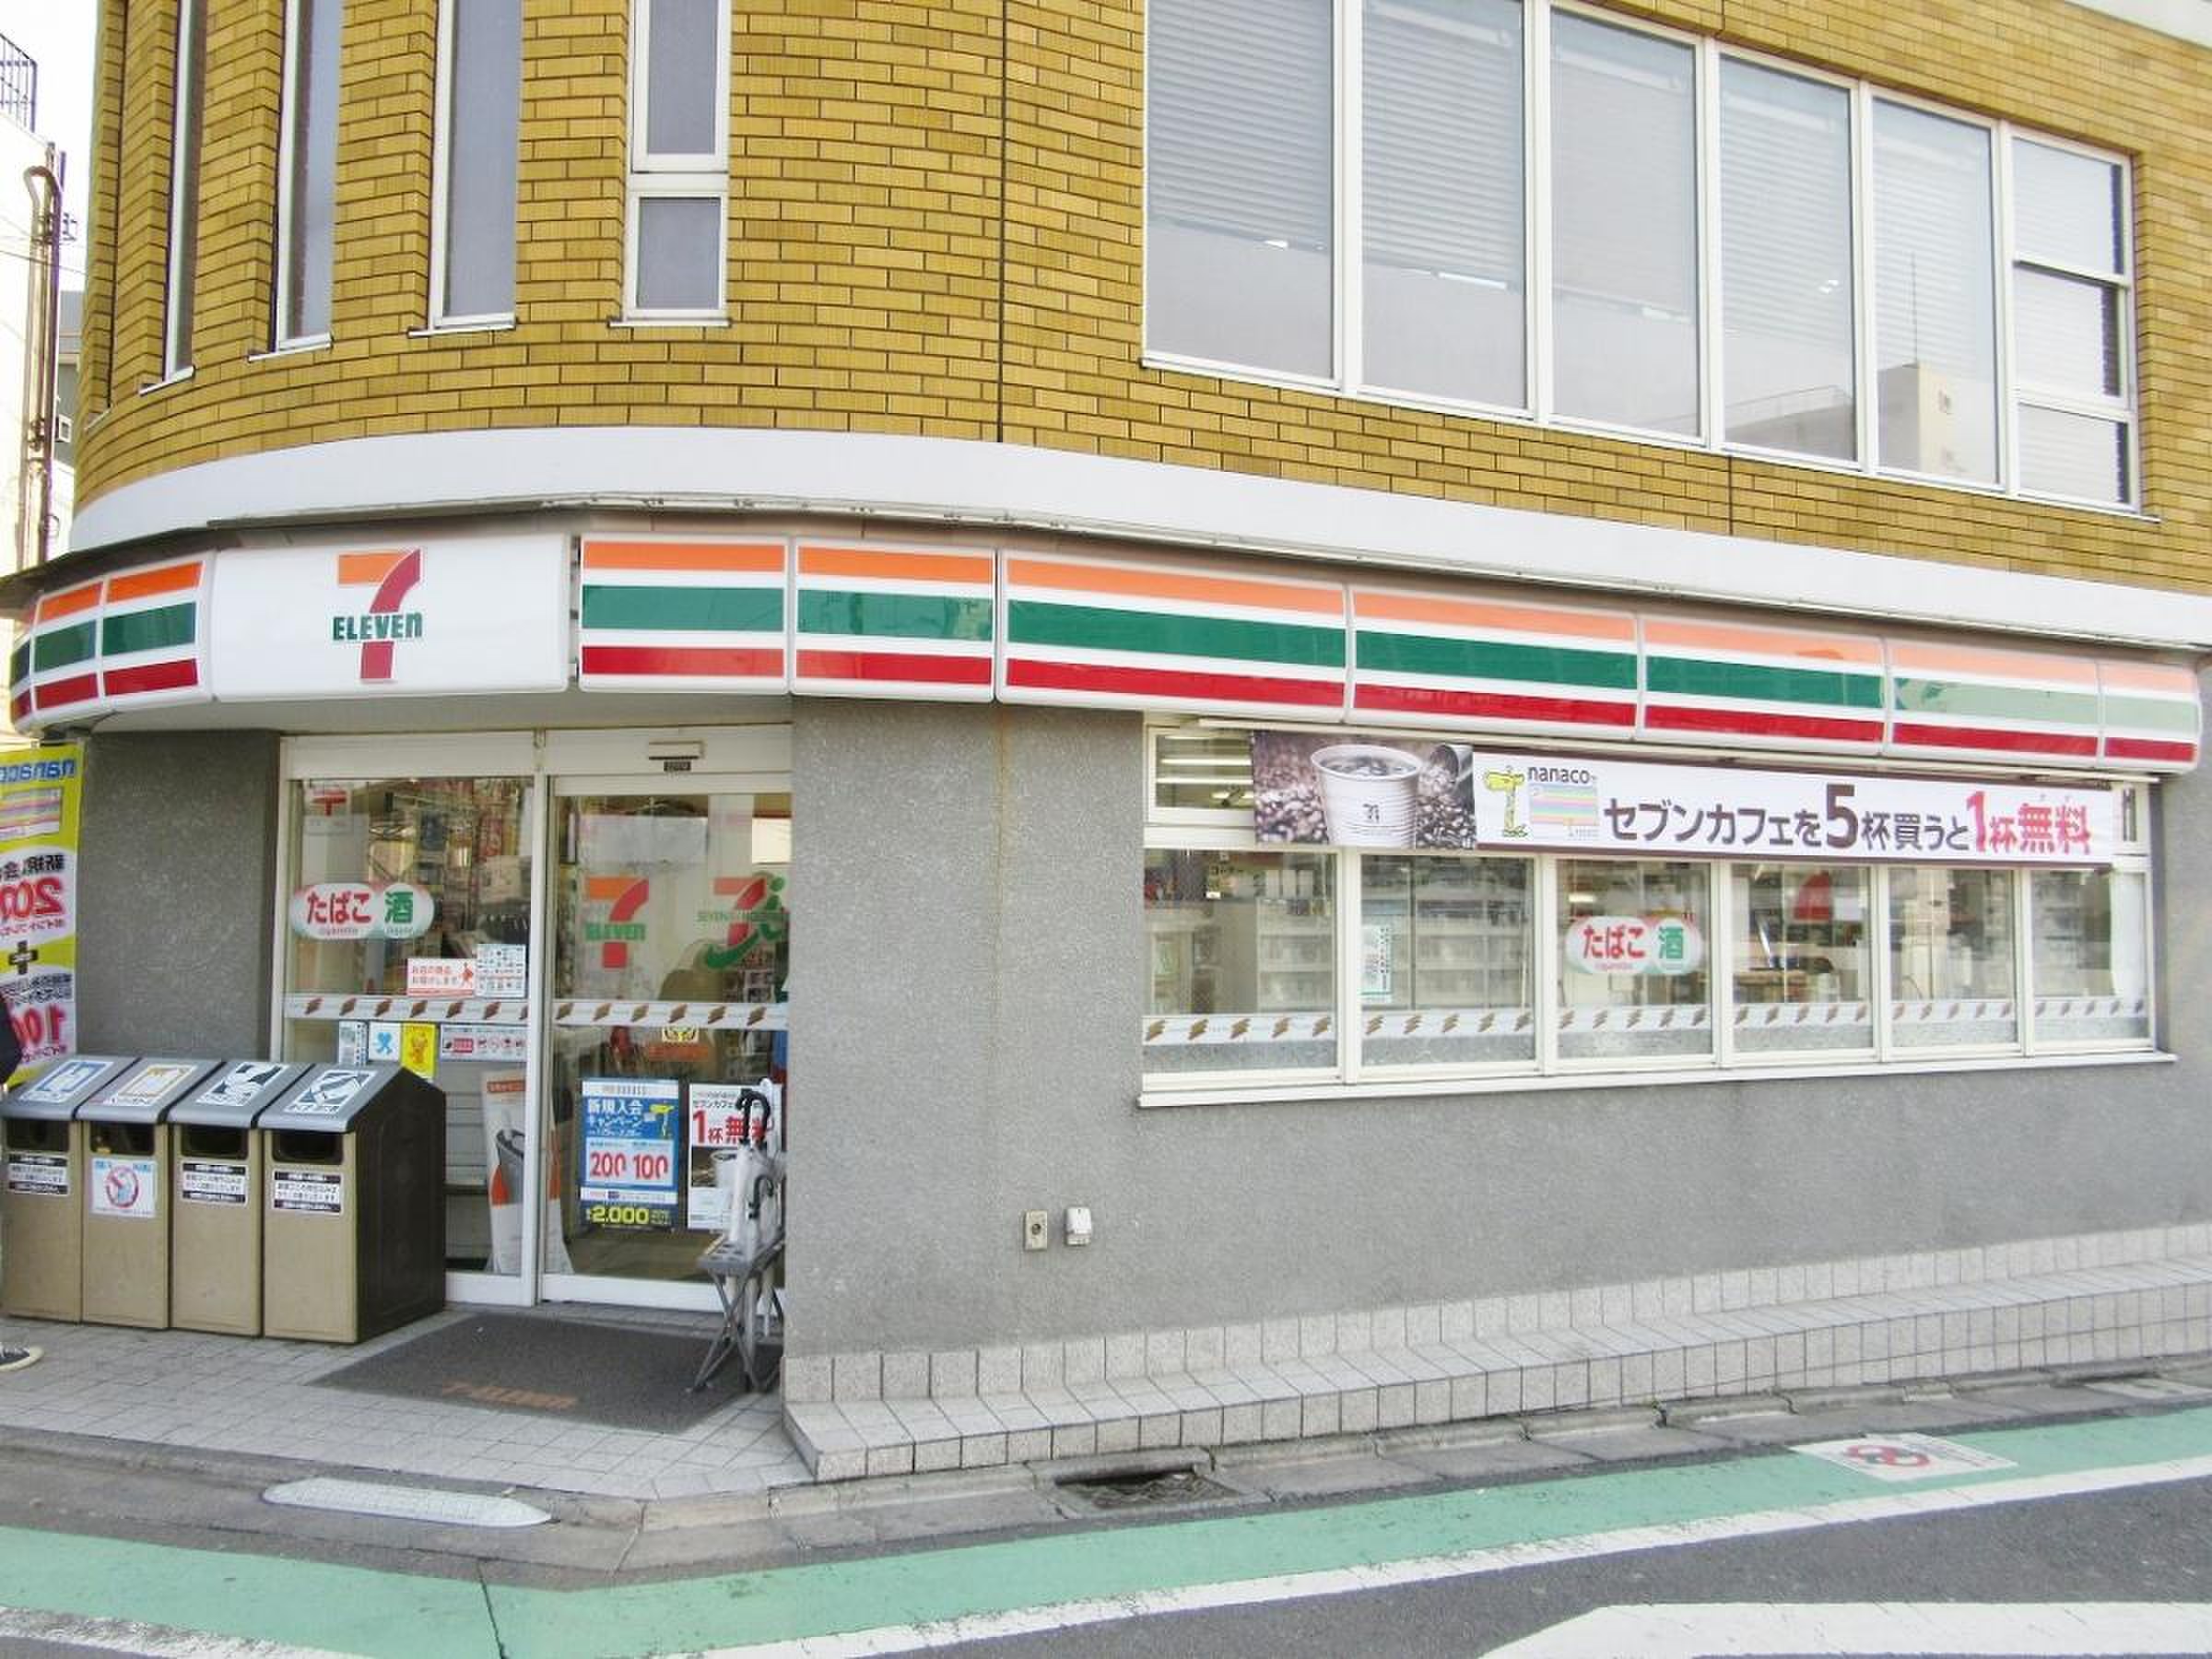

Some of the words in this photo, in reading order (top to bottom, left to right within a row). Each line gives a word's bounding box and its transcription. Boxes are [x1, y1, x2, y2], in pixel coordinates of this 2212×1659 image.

[338, 549, 421, 679] 7
[1528, 766, 1591, 784] nanaco
[307, 890, 371, 924] たばこ
[384, 891, 414, 924] 酒
[1583, 924, 1645, 959] たばこ
[1658, 926, 1684, 959] 酒
